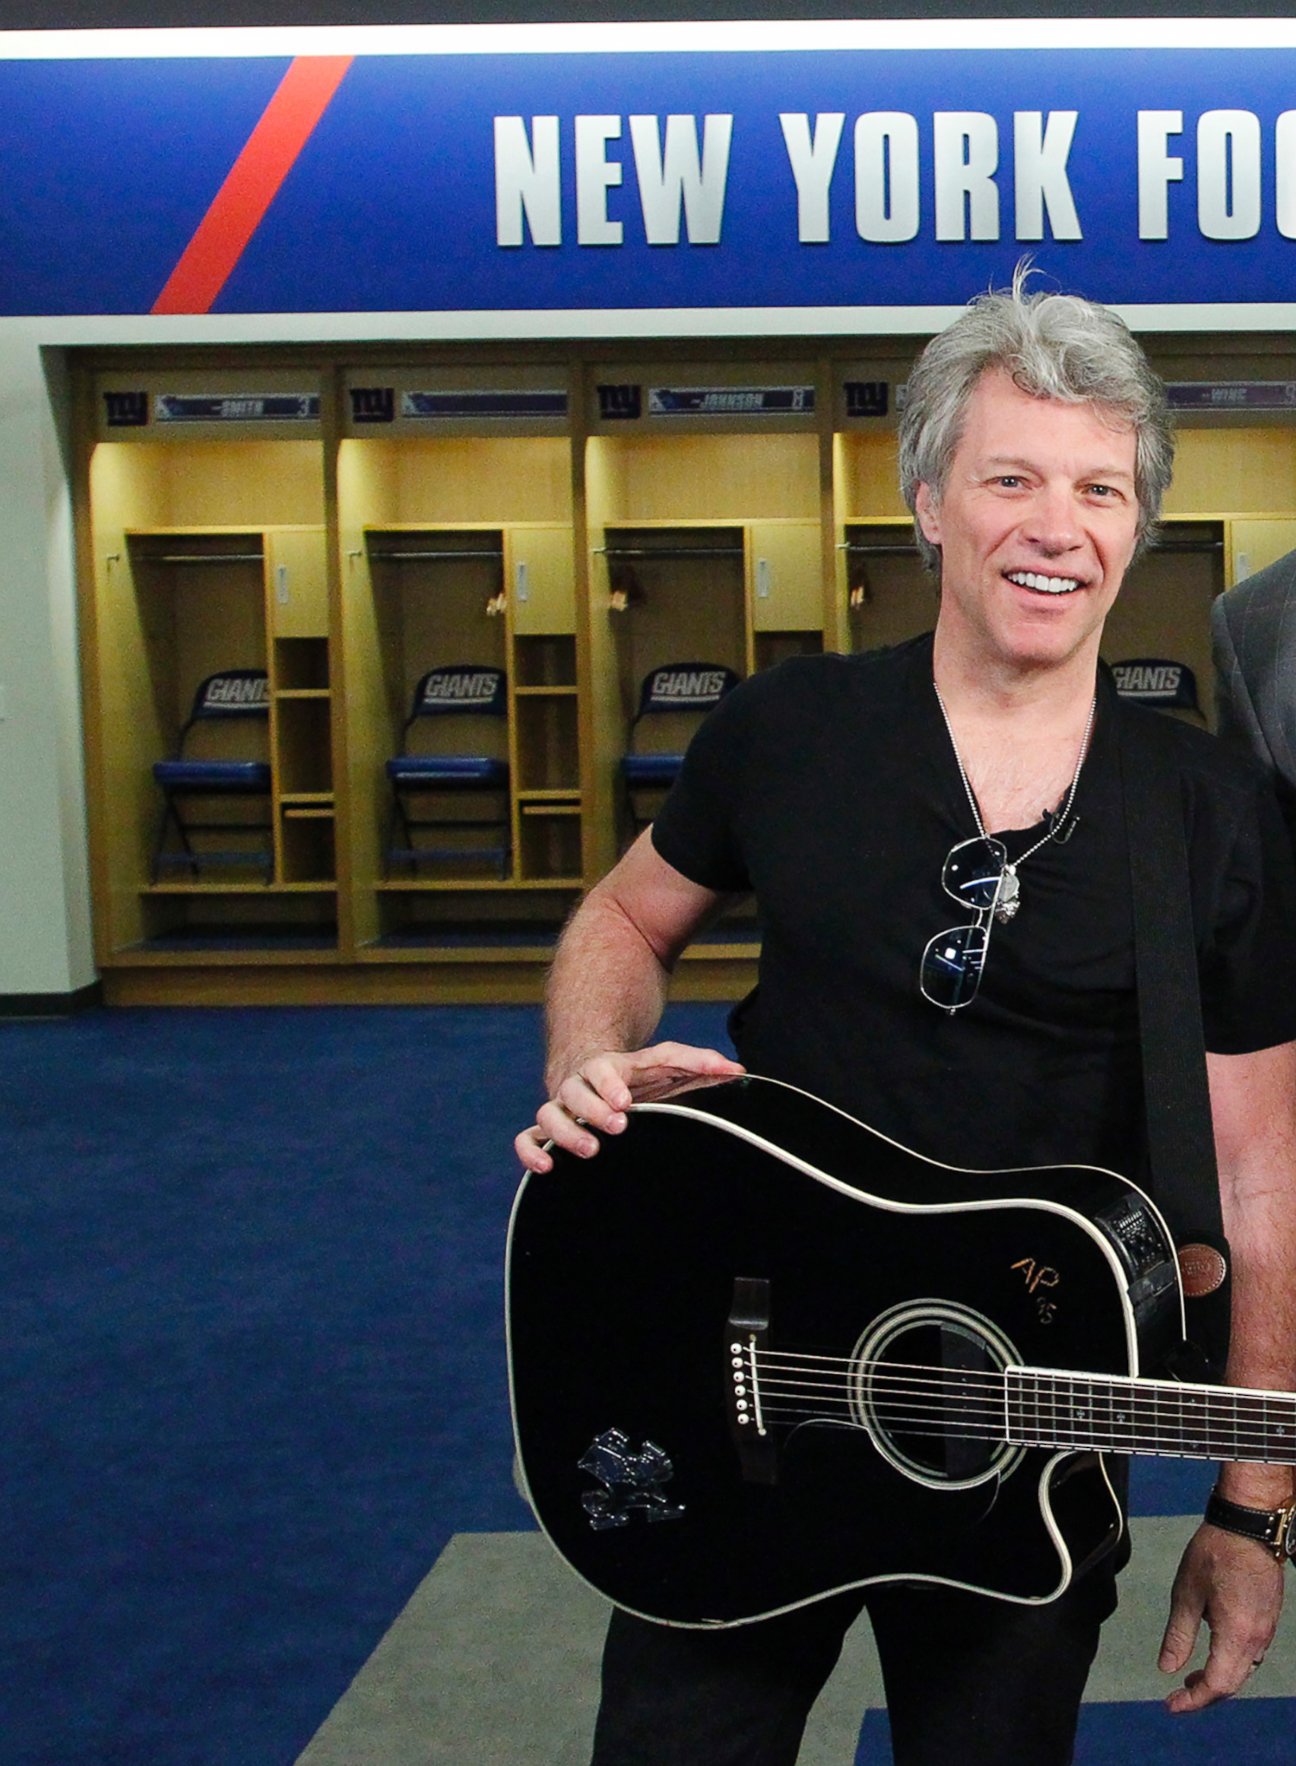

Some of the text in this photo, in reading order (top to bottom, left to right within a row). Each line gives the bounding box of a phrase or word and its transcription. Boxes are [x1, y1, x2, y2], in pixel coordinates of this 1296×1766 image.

[493, 113, 734, 247] NEW
[779, 110, 1083, 244] YORK
[206, 678, 267, 702] GIANT
[424, 673, 499, 698] GIANTS
[651, 671, 726, 696] GIANTS
